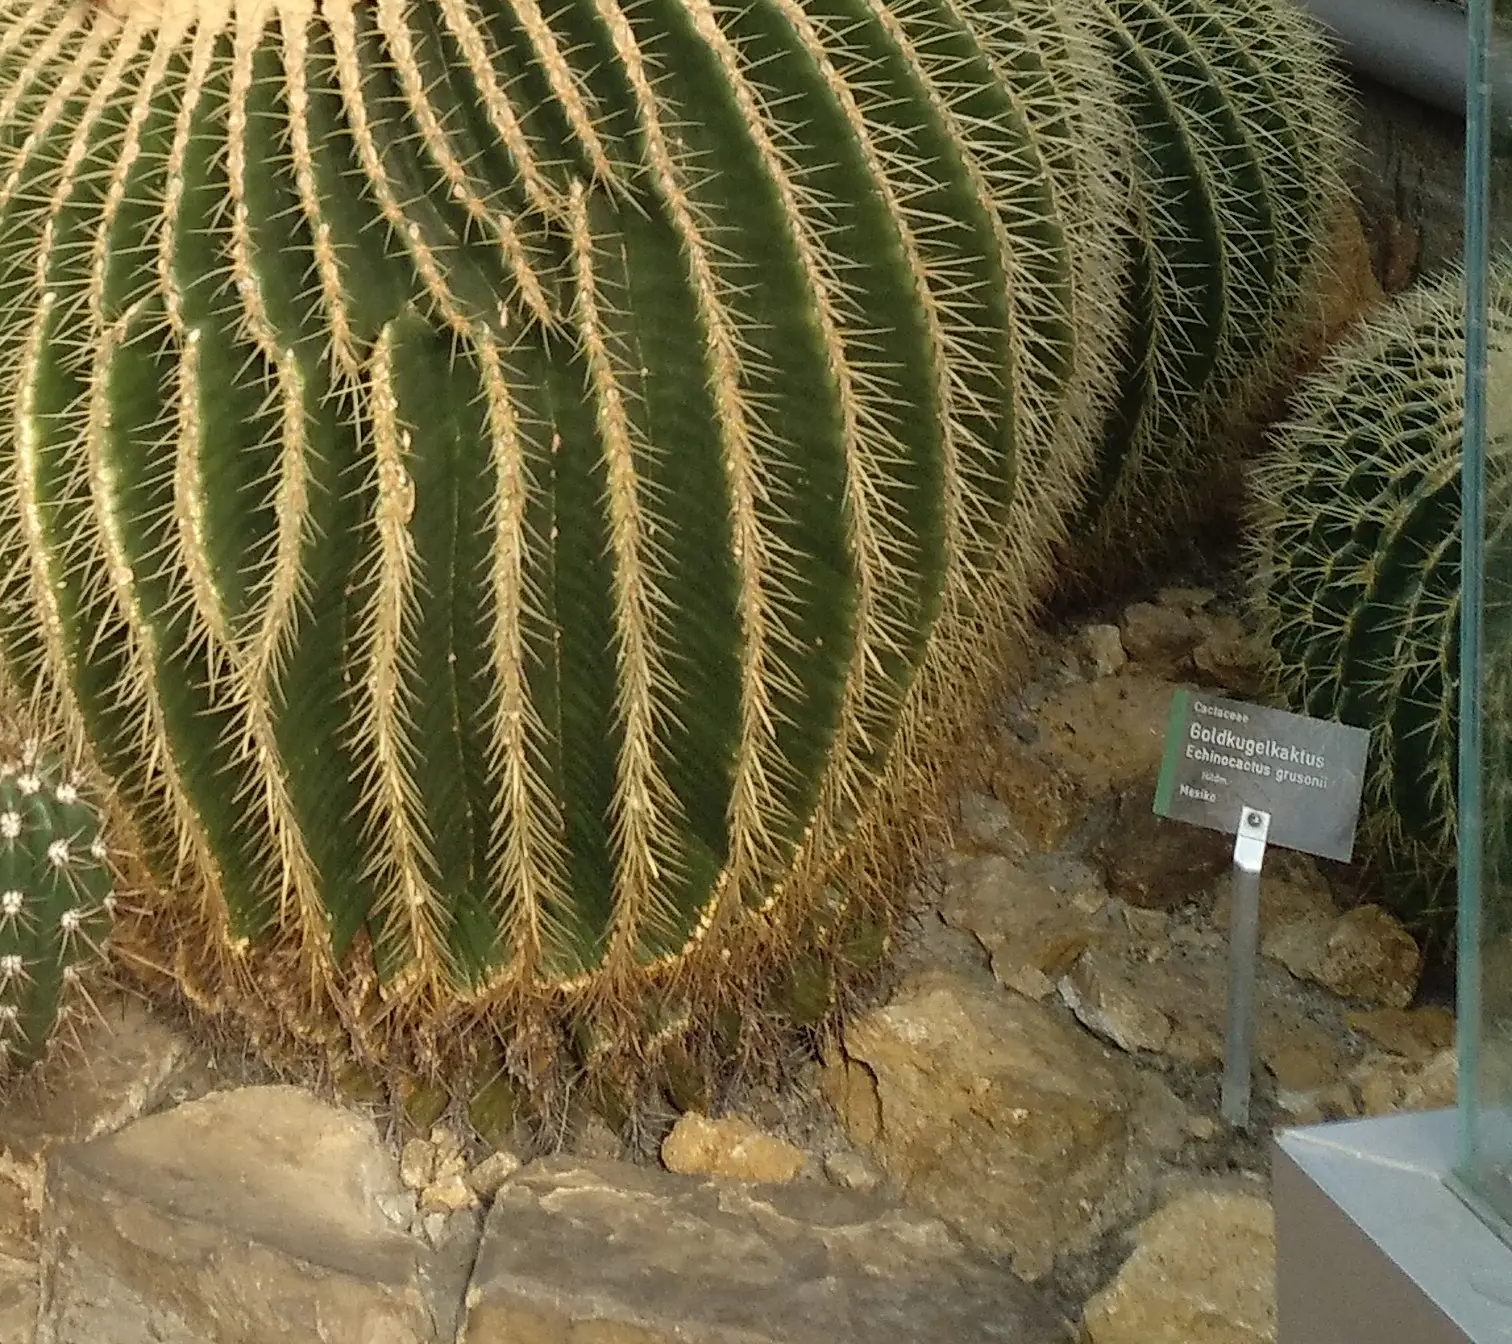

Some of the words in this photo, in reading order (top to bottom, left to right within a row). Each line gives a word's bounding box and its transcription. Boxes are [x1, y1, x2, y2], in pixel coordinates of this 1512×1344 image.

[1194, 701, 1249, 723] Cactaceae
[1185, 745, 1271, 776] Echinocactus
[1275, 768, 1328, 789] grusonii
[1190, 723, 1325, 768] Goldkugelkaktus
